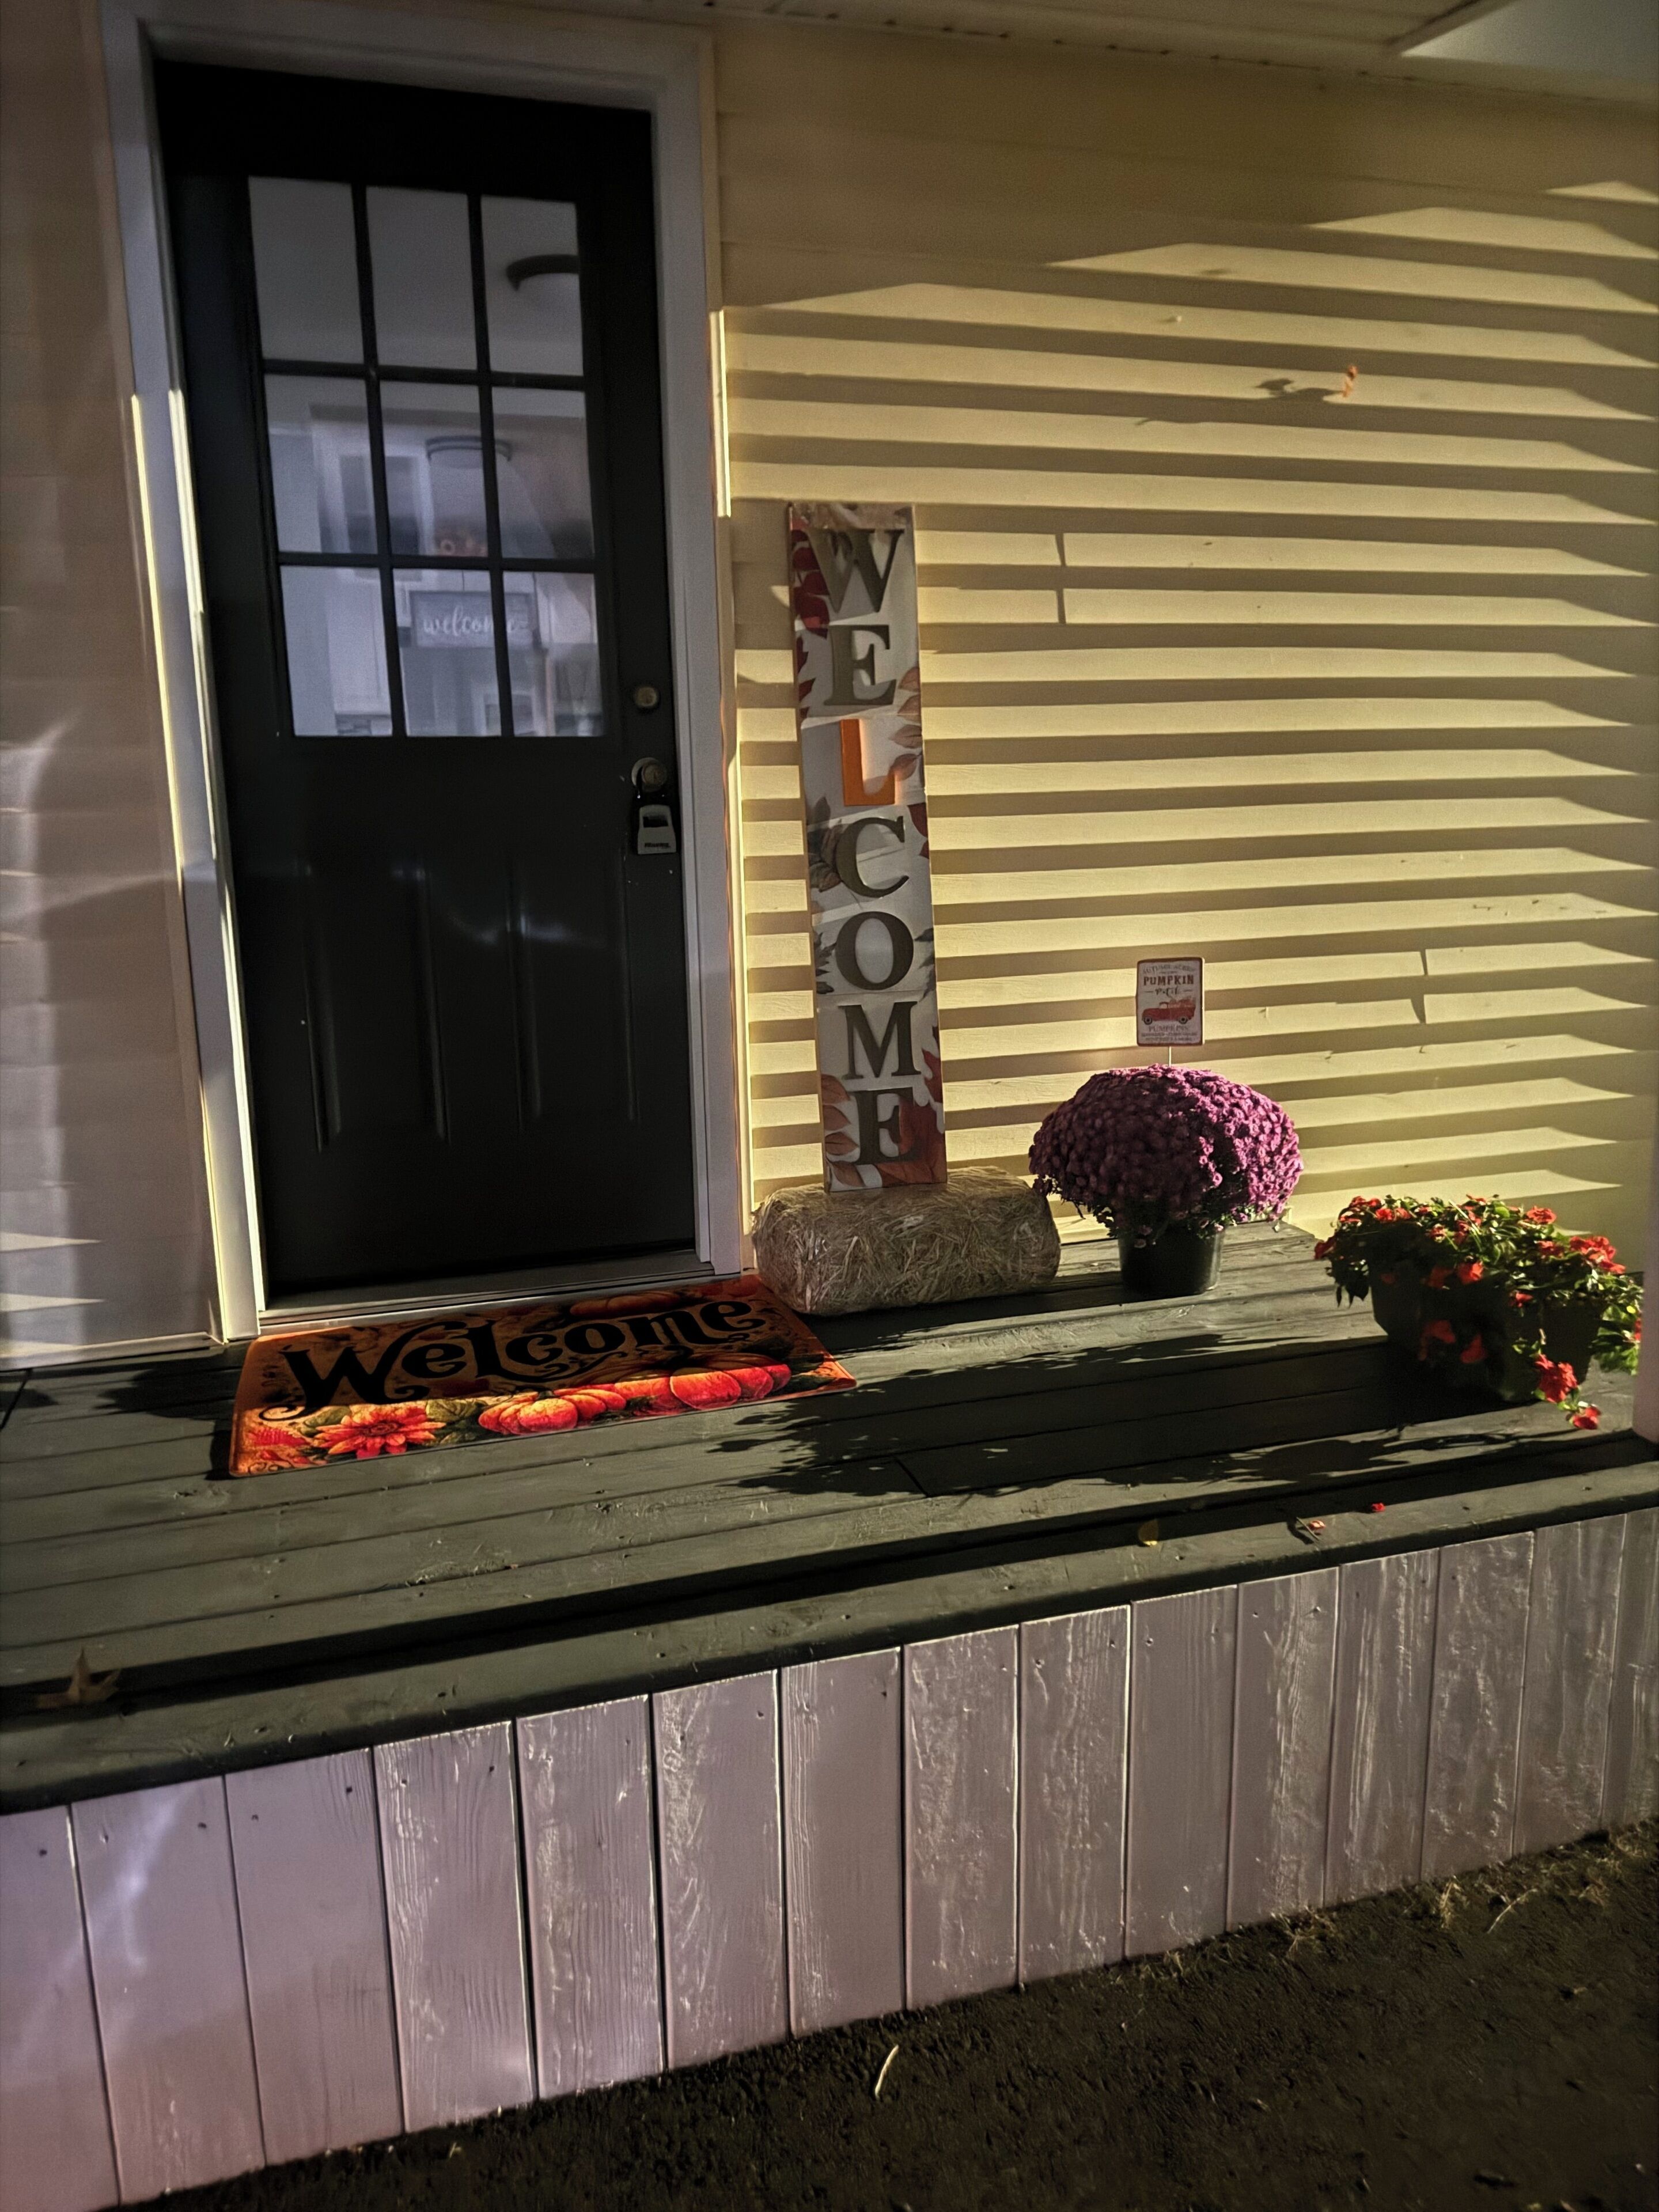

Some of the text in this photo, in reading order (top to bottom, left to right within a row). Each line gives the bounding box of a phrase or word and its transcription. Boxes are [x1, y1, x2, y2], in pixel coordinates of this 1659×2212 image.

[806, 528, 922, 1165] WELCOME
[1143, 974, 1194, 986] PUMPKIN
[259, 1301, 766, 1422] Welcome
